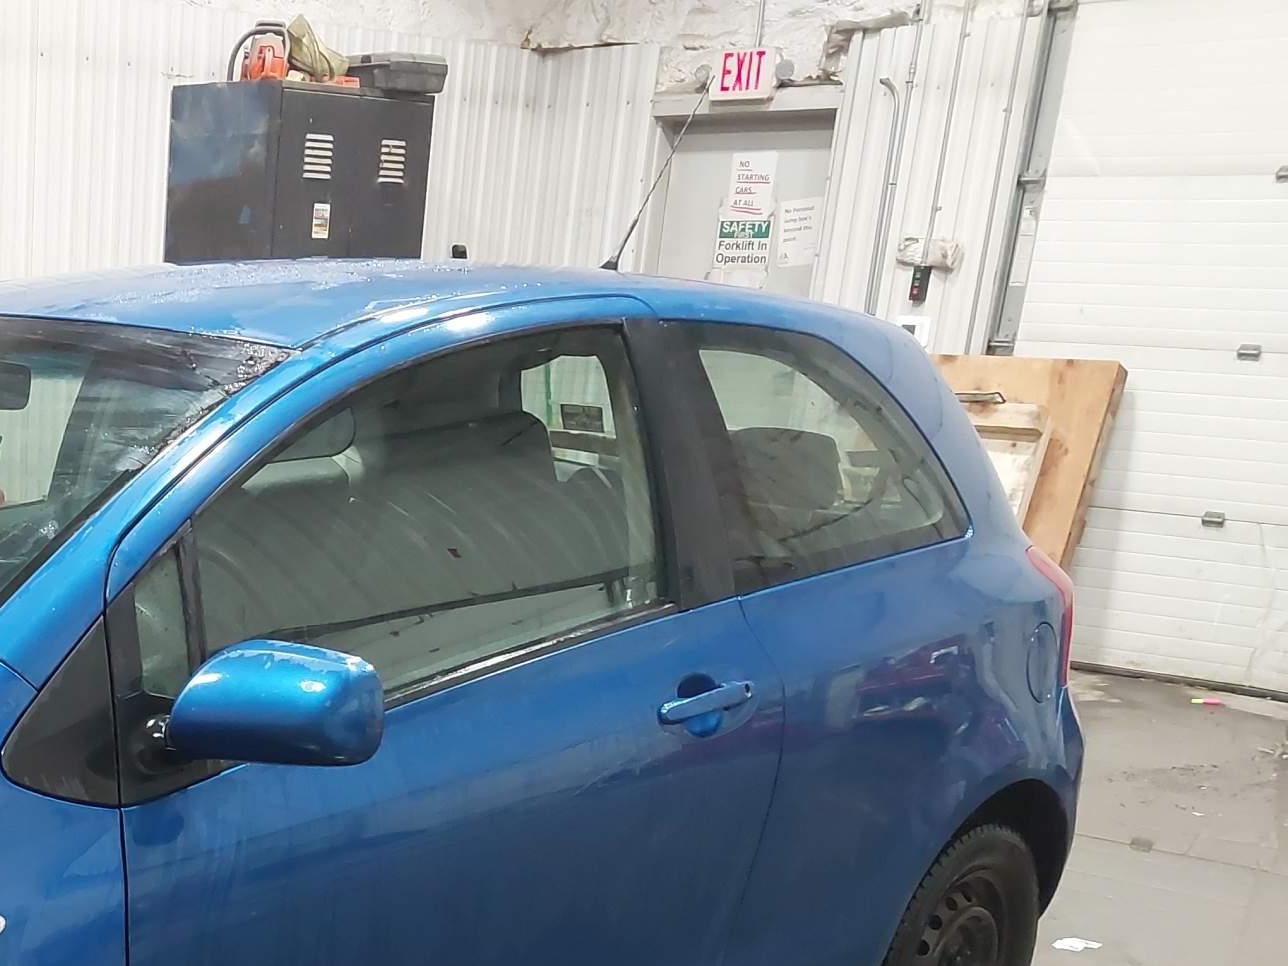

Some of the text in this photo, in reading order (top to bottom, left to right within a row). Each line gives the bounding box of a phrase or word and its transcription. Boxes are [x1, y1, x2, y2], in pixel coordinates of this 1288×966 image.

[720, 50, 766, 91] EXIT
[739, 160, 750, 168] NO
[737, 173, 770, 181] STARTING
[722, 221, 769, 233] SAFETY
[718, 240, 767, 251] Forklift In
[715, 253, 767, 266] Operation
